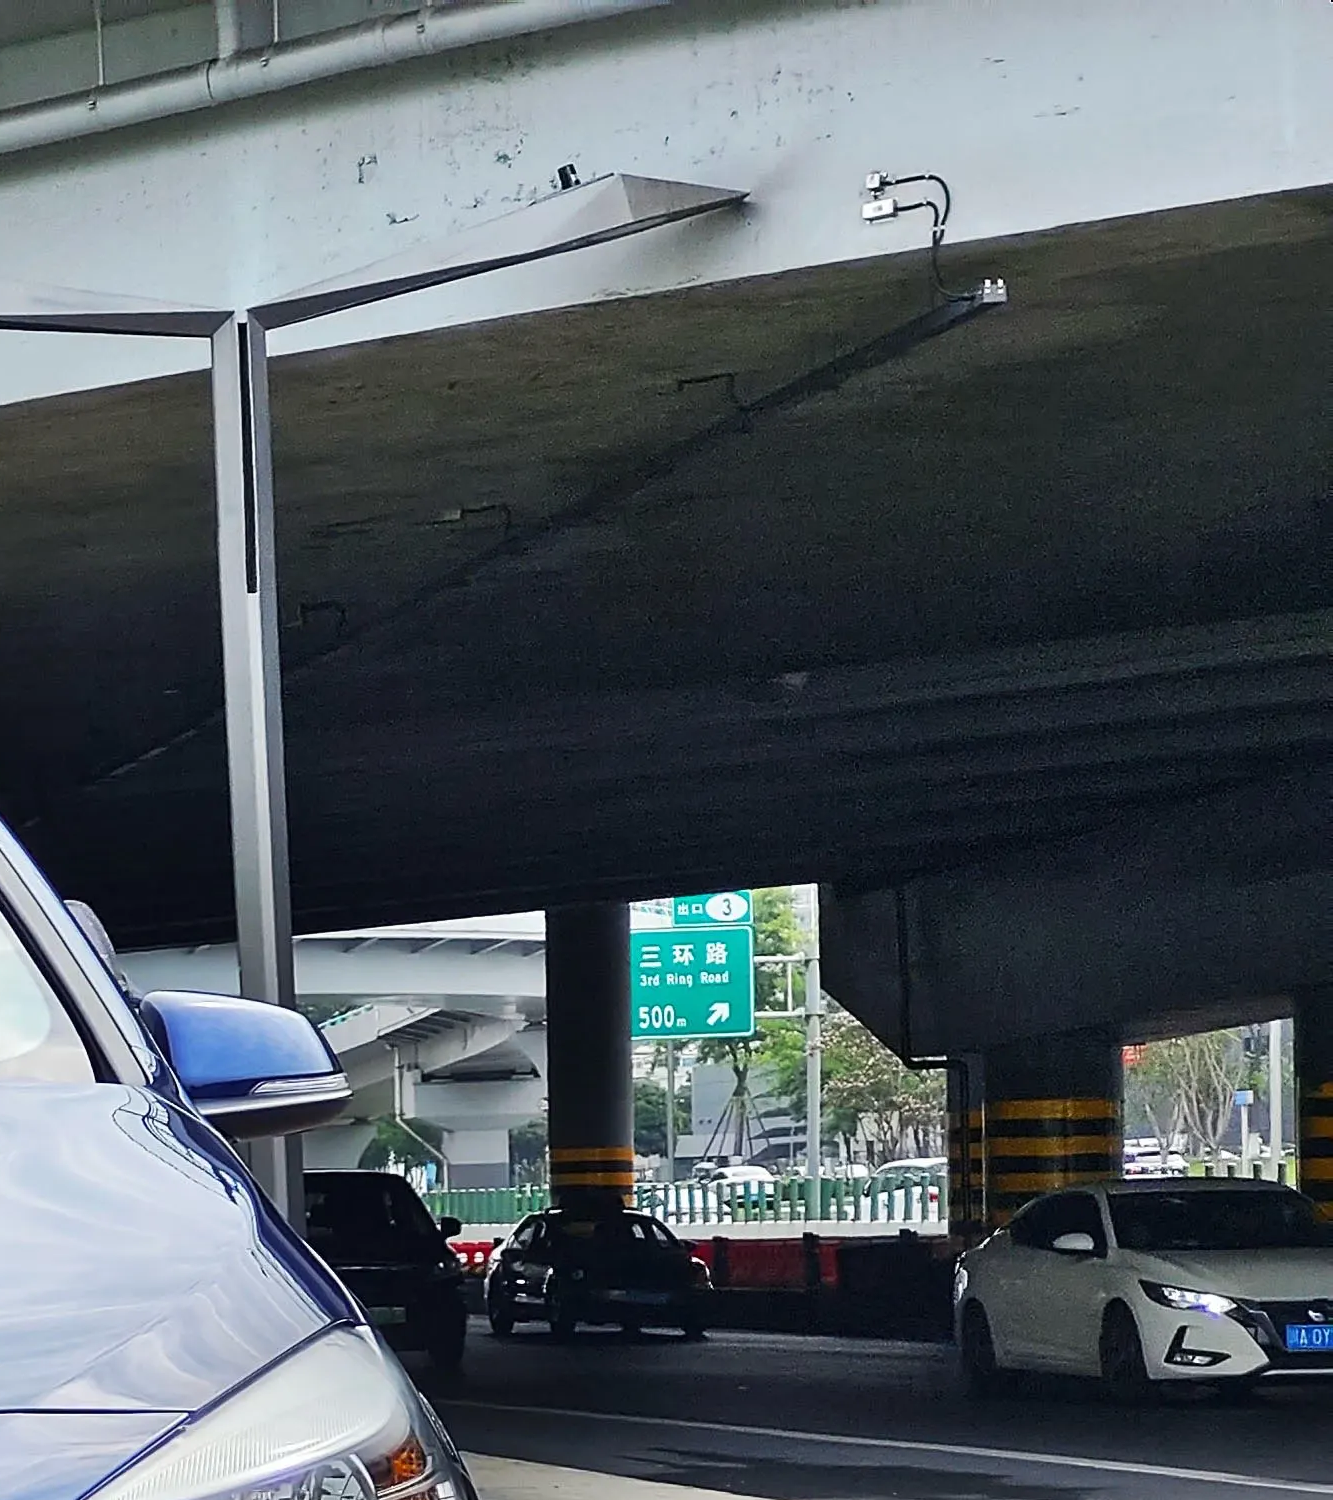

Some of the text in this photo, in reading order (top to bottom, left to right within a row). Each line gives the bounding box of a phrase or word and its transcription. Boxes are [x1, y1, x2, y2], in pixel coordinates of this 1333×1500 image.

[677, 898, 732, 916] 出口 3
[639, 942, 728, 968] 三环路
[640, 971, 729, 988] 3rd Ring Road
[639, 1005, 687, 1029] 500m
